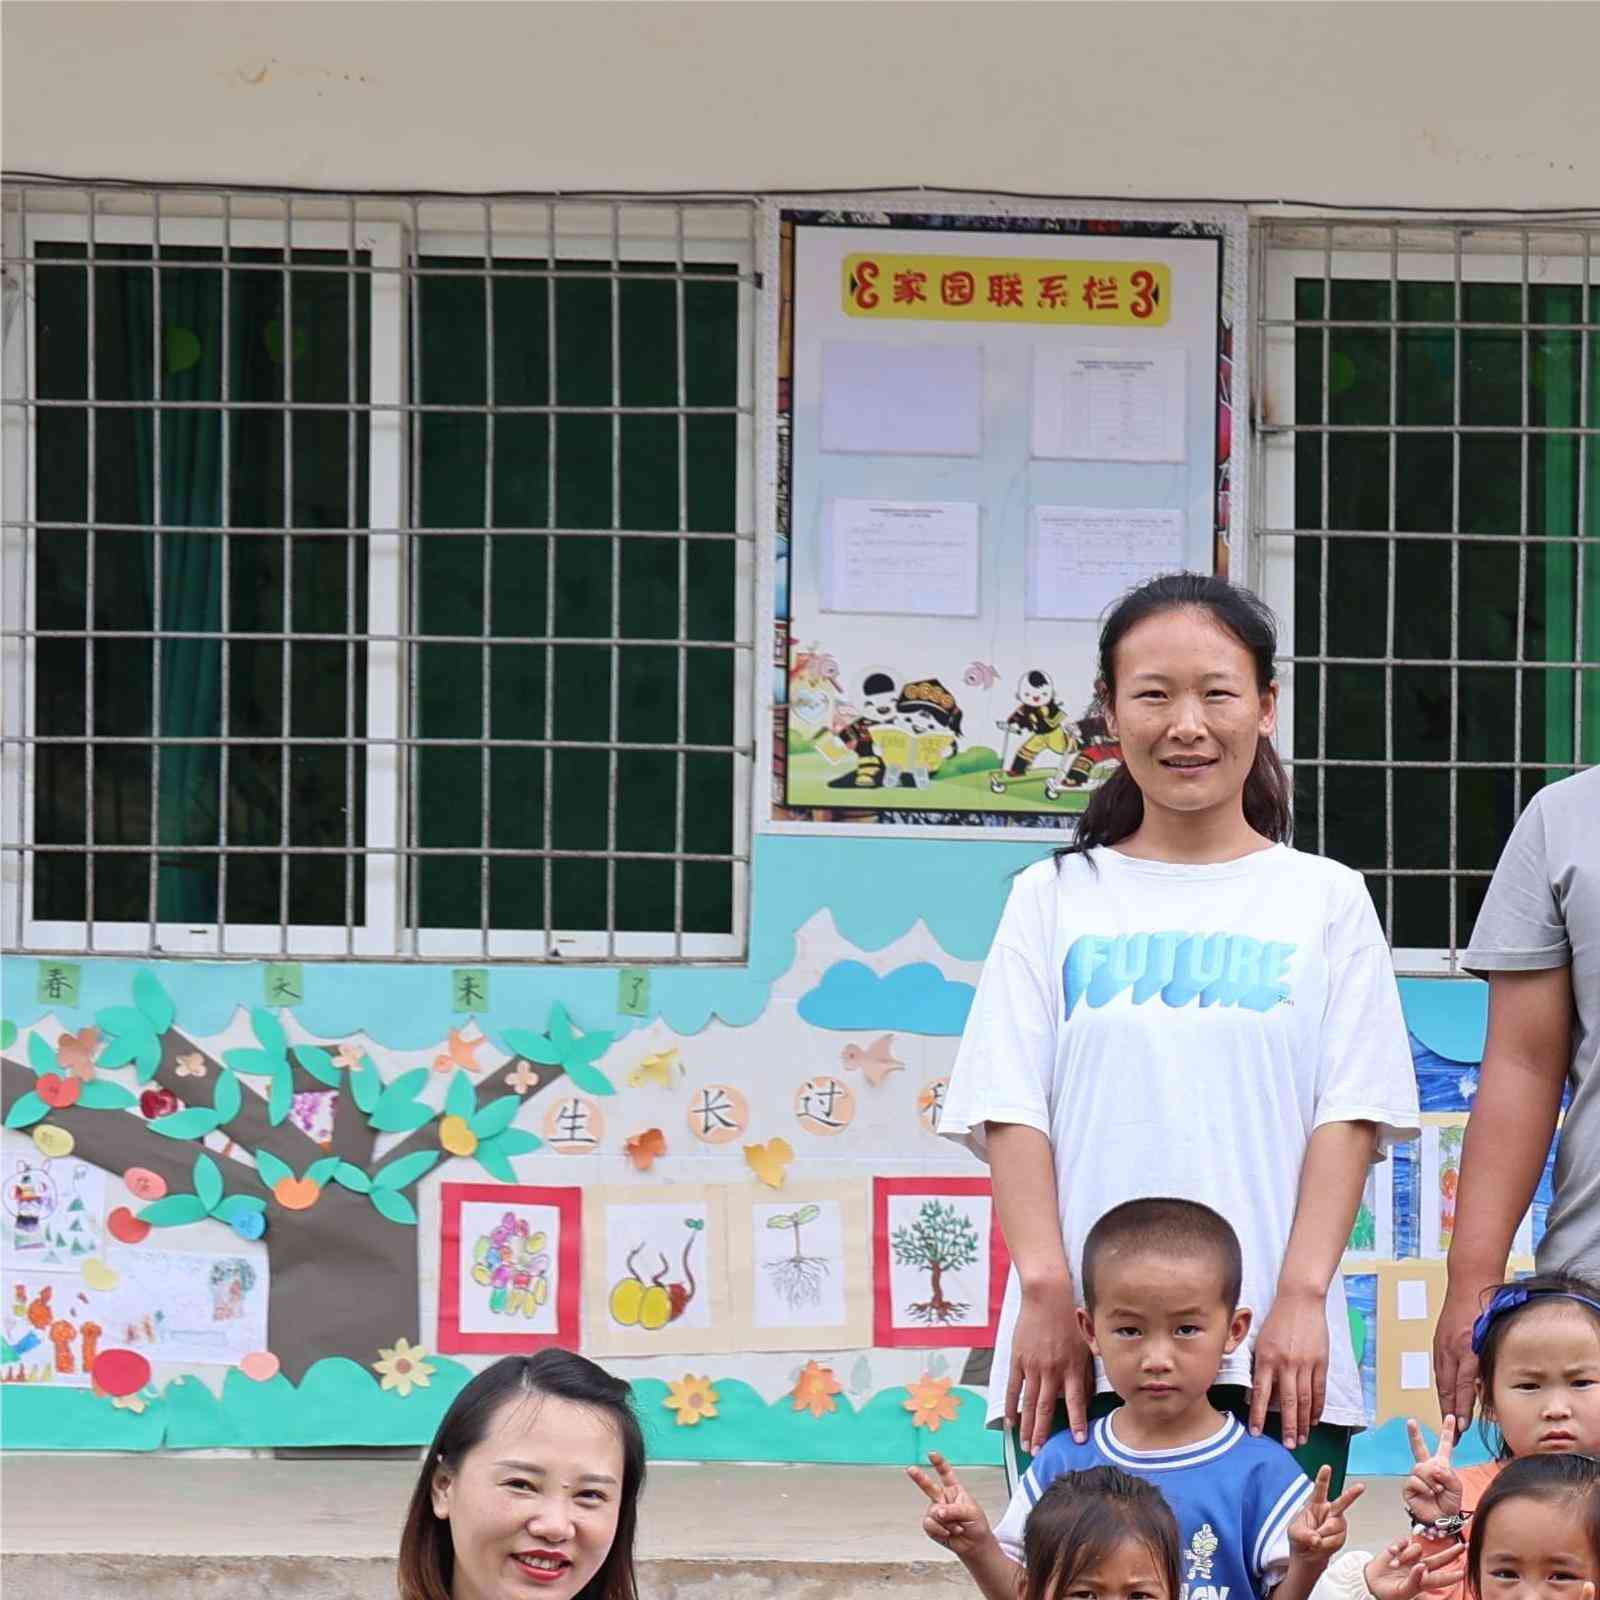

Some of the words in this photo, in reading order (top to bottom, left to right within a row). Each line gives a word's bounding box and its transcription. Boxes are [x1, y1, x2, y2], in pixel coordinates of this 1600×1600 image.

[893, 270, 1119, 310] 家园联系栏
[1066, 931, 1297, 1010] FUTURE
